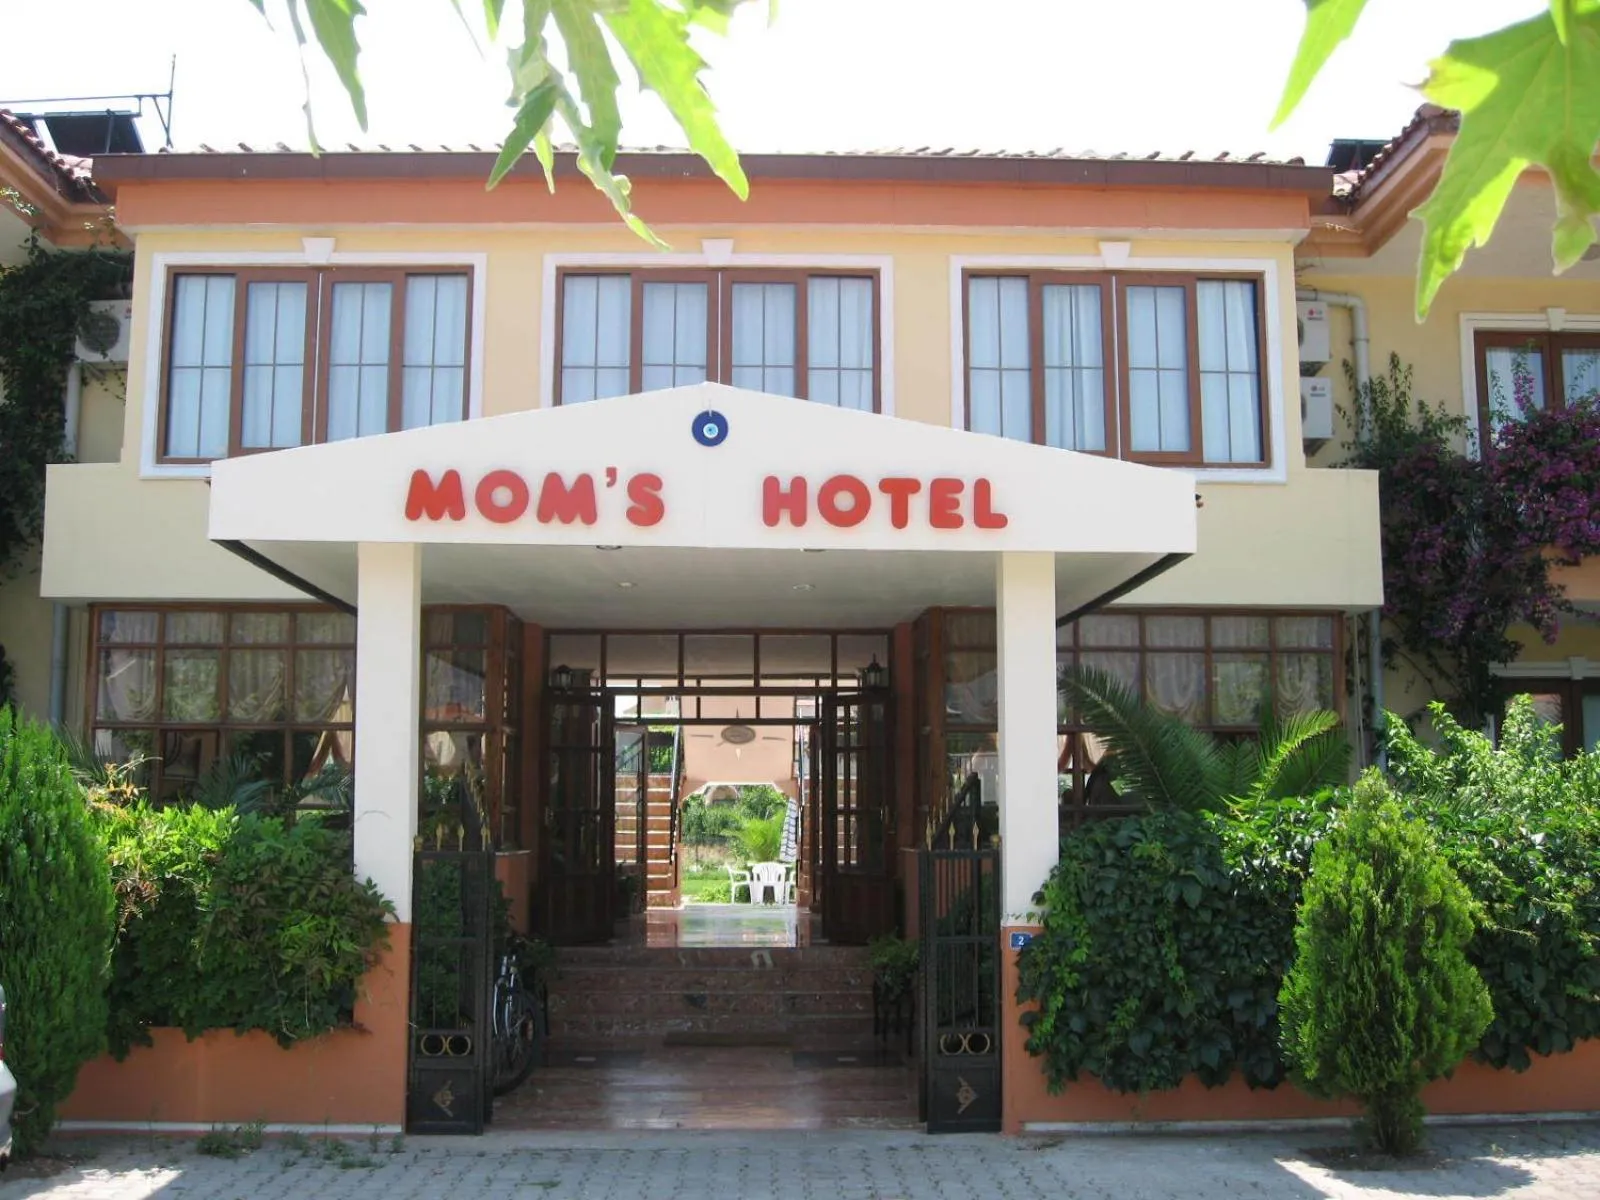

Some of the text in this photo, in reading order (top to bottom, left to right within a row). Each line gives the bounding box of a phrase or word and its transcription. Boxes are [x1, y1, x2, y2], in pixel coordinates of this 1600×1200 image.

[405, 467, 1008, 529] MOM'S HOTEL
[1018, 935, 1025, 946] 2
